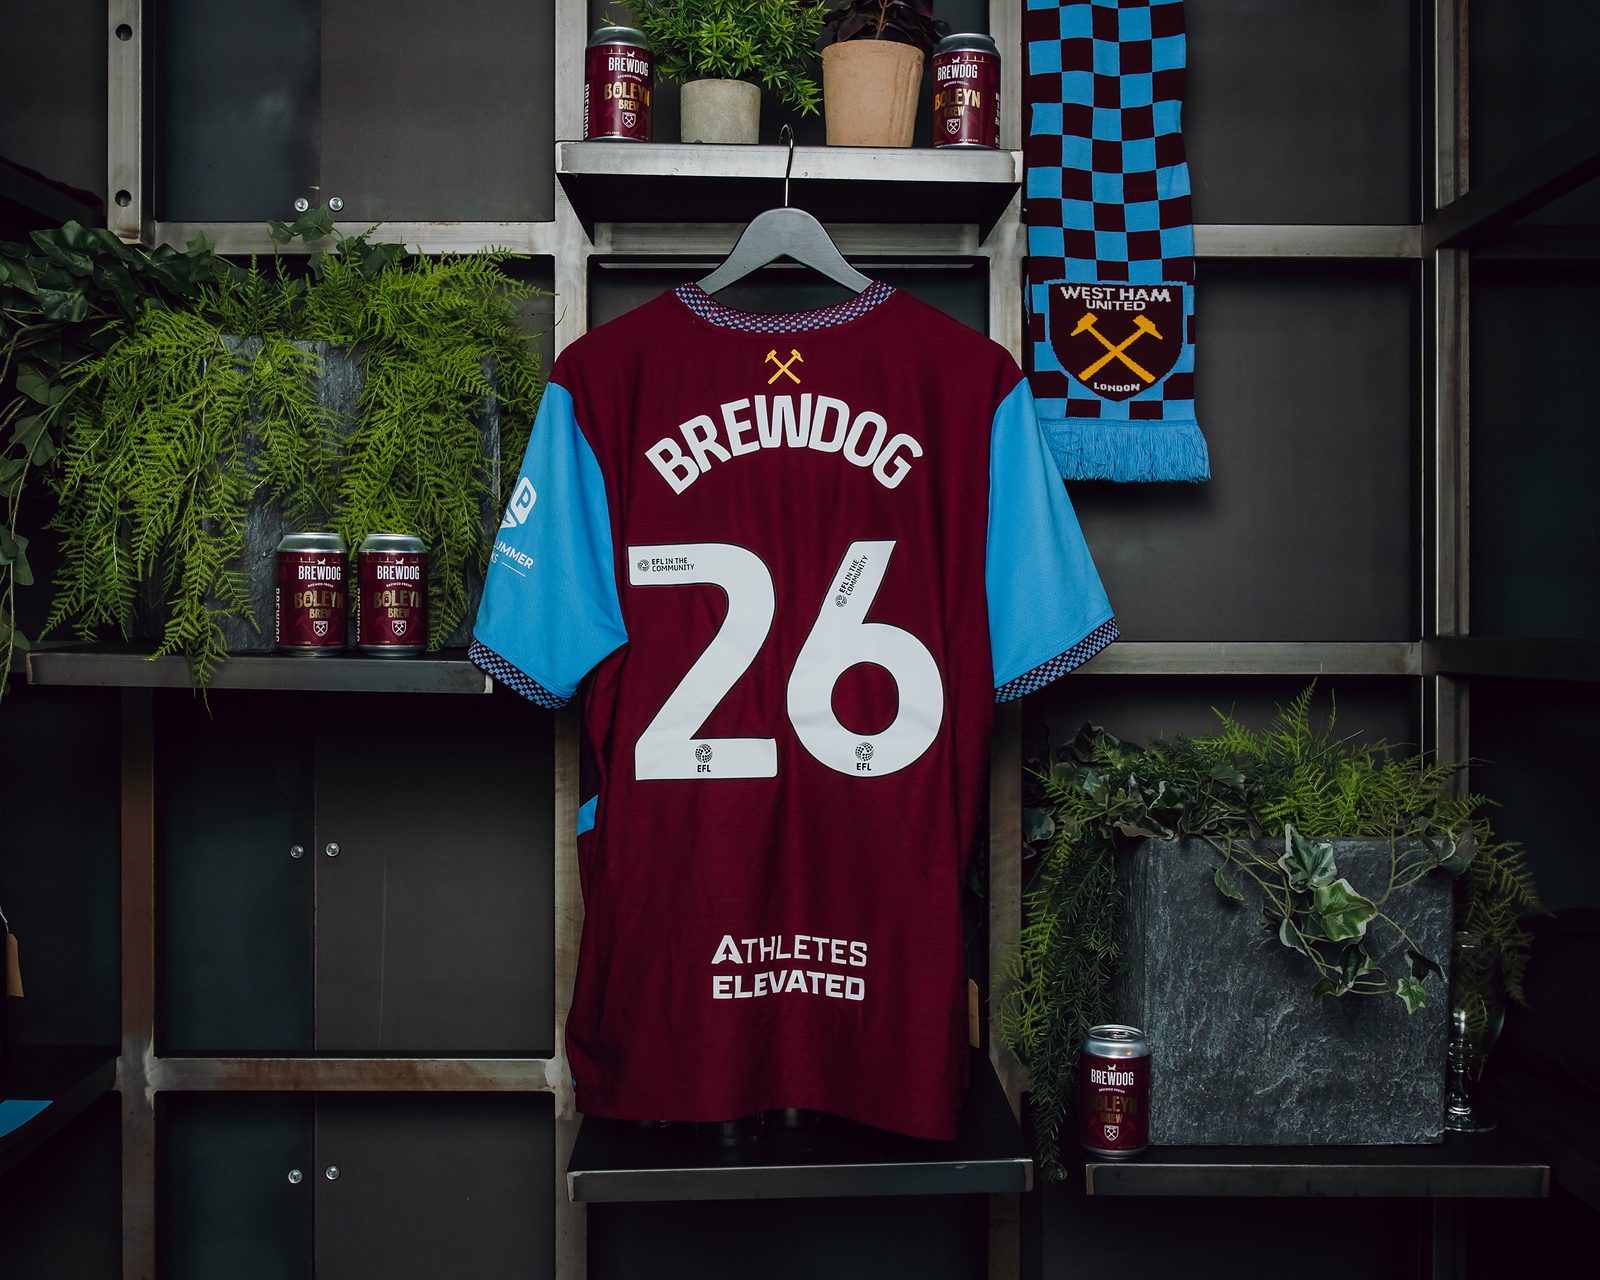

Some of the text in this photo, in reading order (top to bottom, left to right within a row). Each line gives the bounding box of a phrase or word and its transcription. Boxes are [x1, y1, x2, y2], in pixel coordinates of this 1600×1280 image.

[608, 57, 648, 77] BREWDOG
[937, 64, 978, 81] BREWDOG
[604, 81, 650, 107] BOLEYN
[934, 88, 980, 112] BOLEYN
[618, 99, 639, 111] BREW
[1060, 286, 1171, 302] WEST HAM
[1086, 299, 1146, 311] UNITED
[1093, 382, 1140, 392] LONDON
[644, 393, 923, 495] BREWDOG
[298, 565, 341, 580] BREWDOG
[376, 565, 420, 580] BREWDOG
[652, 563, 695, 572] COMMUNITY
[839, 558, 860, 593] EFL IN THE
[845, 554, 868, 596] COMMUNITY
[294, 590, 343, 609] BOLEYN
[374, 590, 422, 609] BOLEYN
[309, 608, 332, 619] BREW
[388, 607, 410, 618] BREW
[697, 764, 711, 772] EFL
[857, 762, 872, 771] EFL
[711, 935, 867, 967] ATHLETES
[712, 970, 865, 1001] ELEVATED
[1091, 1068, 1134, 1086] BREWDOG
